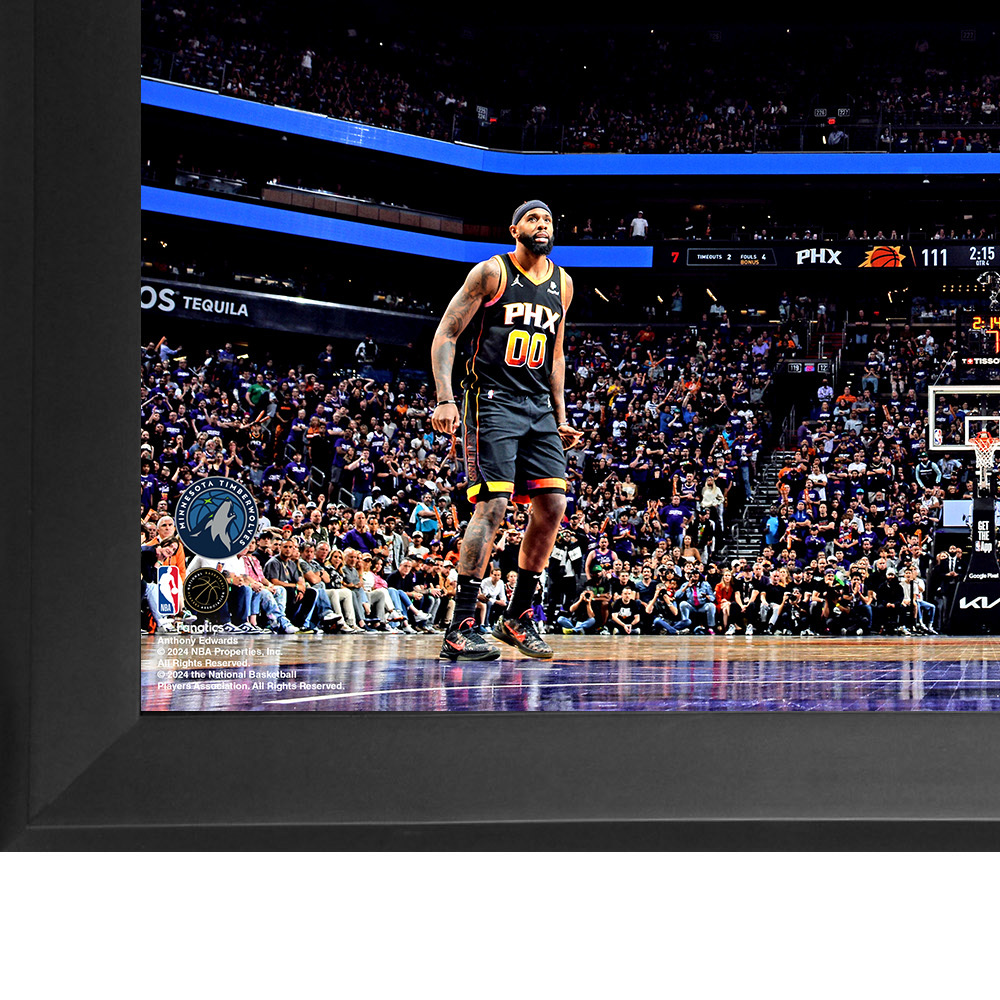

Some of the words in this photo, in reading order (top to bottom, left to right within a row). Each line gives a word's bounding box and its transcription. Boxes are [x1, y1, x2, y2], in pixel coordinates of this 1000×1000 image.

[671, 252, 680, 263] 7
[795, 248, 842, 266] PHX
[922, 248, 947, 266] 111
[969, 246, 995, 261] 2:15
[183, 295, 249, 317] TEQUILA
[503, 302, 561, 335] PHX
[504, 329, 548, 370] 00
[977, 520, 989, 531] GET
[977, 530, 989, 540] THE
[980, 541, 992, 553] App
